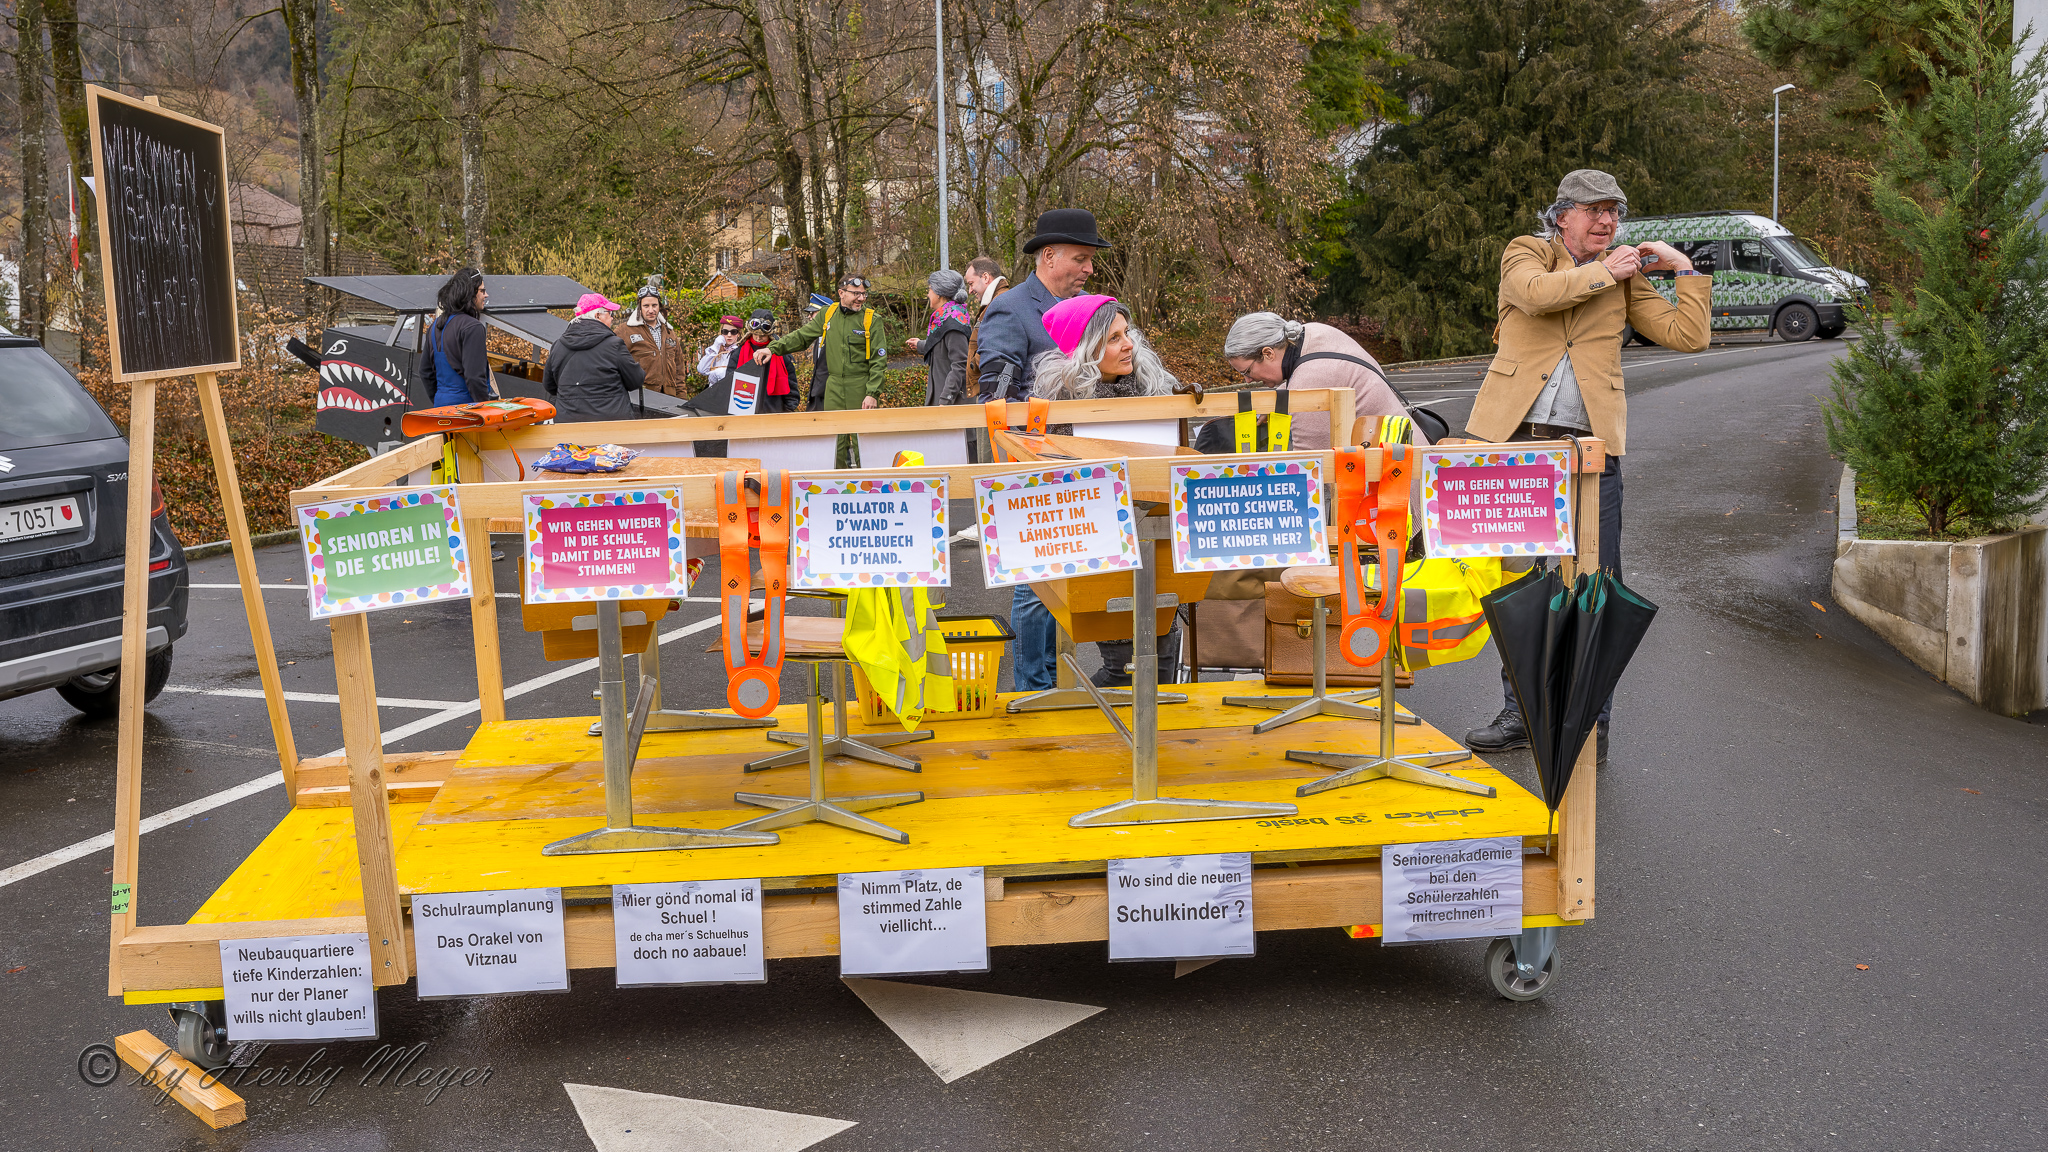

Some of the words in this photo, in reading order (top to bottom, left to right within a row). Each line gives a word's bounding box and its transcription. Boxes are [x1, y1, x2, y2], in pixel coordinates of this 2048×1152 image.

[1194, 484, 1263, 500] SCHULHAUS
[1267, 482, 1301, 497] LEER,
[1443, 480, 1466, 491] WIR
[1469, 479, 1504, 491] GEHEN
[1508, 477, 1549, 489] WIEDER
[1007, 493, 1051, 511] MATHE
[1056, 487, 1101, 505] BÜFFLE
[1457, 494, 1470, 505] IN
[1473, 494, 1490, 505] DIE
[1494, 492, 1536, 505] SCHULE,
[832, 501, 895, 515] ROLLATOR
[900, 501, 909, 514] A
[1027, 509, 1064, 525] STATT
[1069, 506, 1086, 519] IM
[1197, 502, 1240, 516] KONTO
[1244, 499, 1298, 514] SCHWER,
[1446, 508, 1481, 520] DAMIT
[1485, 508, 1503, 519] DIE
[1506, 506, 1547, 518] ZAHLEN
[547, 521, 572, 533] WIR
[576, 519, 614, 532] GEHEN
[617, 516, 662, 530] WIEDER
[1018, 522, 1098, 543] LÄHNSTUEHL
[1194, 520, 1216, 533] WO
[1220, 517, 1273, 532] KRIEGEN
[1278, 515, 1304, 529] WIR
[1471, 521, 1526, 534] STIMMEN!
[328, 526, 414, 555] SENIOREN
[420, 522, 442, 541] IN
[564, 536, 576, 547] IN
[581, 535, 599, 547] DIE
[603, 532, 648, 546] SCHULE,
[828, 535, 913, 549] SCHUELBUECH
[1197, 536, 1219, 549] DIE
[1222, 534, 1269, 548] KINDER
[1272, 532, 1302, 546] HER?
[551, 550, 589, 563] DAMIT
[593, 549, 612, 561] DIE
[616, 546, 661, 559] ZAHLEN
[1034, 540, 1088, 558] MÜFFLE.
[335, 557, 365, 578] DIE
[371, 546, 441, 573] SCHULE!
[841, 553, 845, 565] I
[577, 563, 636, 577] STIMMEN!
[1335, 815, 1372, 825] 3S
[1384, 808, 1485, 819] doka
[1256, 817, 1330, 828] basic
[1392, 846, 1513, 867] Seniorenakademie
[1118, 874, 1140, 888] Wo
[1144, 872, 1173, 887] sind
[1177, 872, 1197, 886] die
[1201, 872, 1242, 884] neuen
[1429, 871, 1449, 884] bei
[1453, 870, 1477, 883] den
[861, 881, 901, 895] Nimm
[905, 879, 942, 894] Platz,
[946, 877, 962, 891] de
[622, 893, 652, 907] Mier
[655, 892, 690, 909] gönd
[695, 889, 737, 904] nomal
[741, 888, 754, 902] id
[1407, 887, 1499, 905] Schülerzahlen
[422, 900, 554, 918] Schulraumplanung
[862, 899, 921, 915] stimmed
[925, 897, 962, 911] Zahle
[1116, 901, 1229, 923] Schulkinder
[1234, 900, 1245, 918] ?
[1412, 907, 1485, 923] mitrechnen
[1489, 906, 1493, 918] !
[661, 910, 708, 925] Schuel
[712, 909, 716, 923] !
[437, 935, 464, 949] Das
[468, 931, 513, 947] Orakel
[517, 932, 543, 944] von
[630, 932, 642, 942] de
[644, 931, 663, 942] cha
[696, 929, 749, 940] Schuelhus
[238, 944, 355, 962] Neubauquartiere
[465, 952, 517, 967] Vitznau
[633, 946, 667, 960] doch
[671, 948, 689, 959] no
[693, 944, 746, 958] aabaue!
[232, 969, 263, 983] tiefe
[267, 964, 362, 981] Kinderzahlen:
[251, 991, 274, 1003] nur
[277, 988, 300, 1001] der
[304, 987, 349, 1001] Planer
[233, 1010, 265, 1024] wills
[268, 1009, 303, 1023] nicht
[306, 1006, 366, 1026] glauben!
